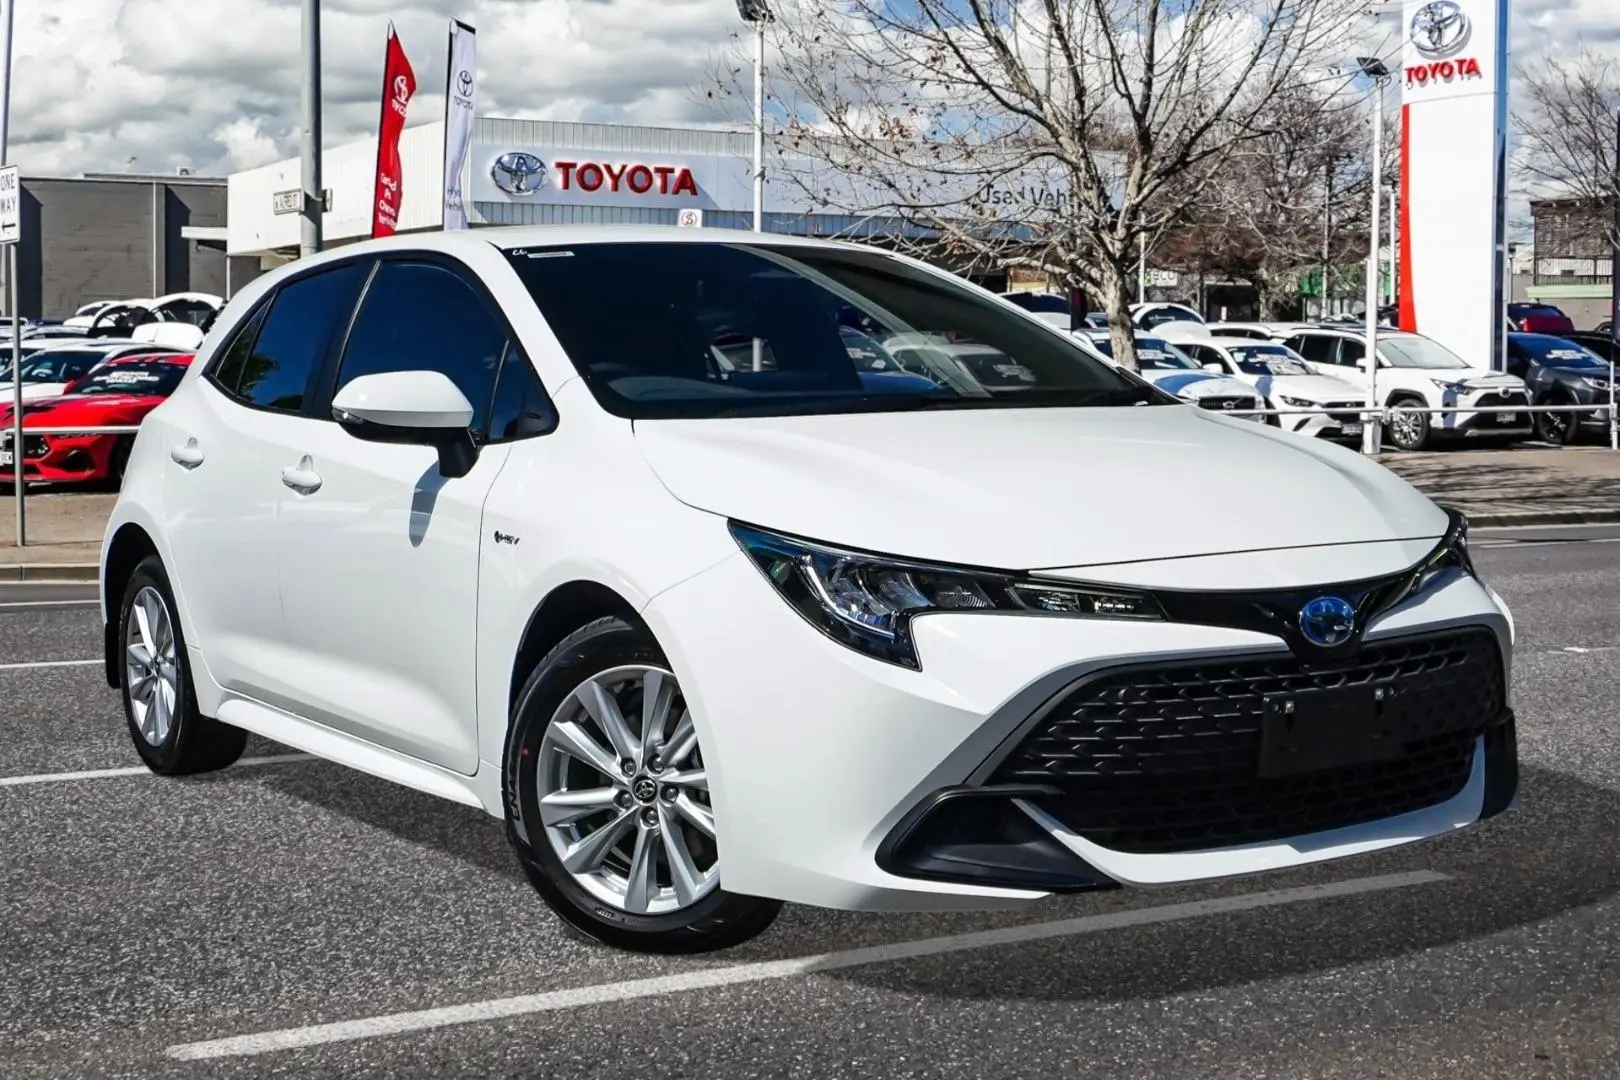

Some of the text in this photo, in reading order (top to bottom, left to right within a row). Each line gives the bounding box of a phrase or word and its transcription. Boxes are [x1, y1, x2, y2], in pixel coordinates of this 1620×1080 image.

[1404, 58, 1481, 83] TOYOTA
[1, 173, 15, 191] ONE
[555, 161, 698, 196] TOYOTA
